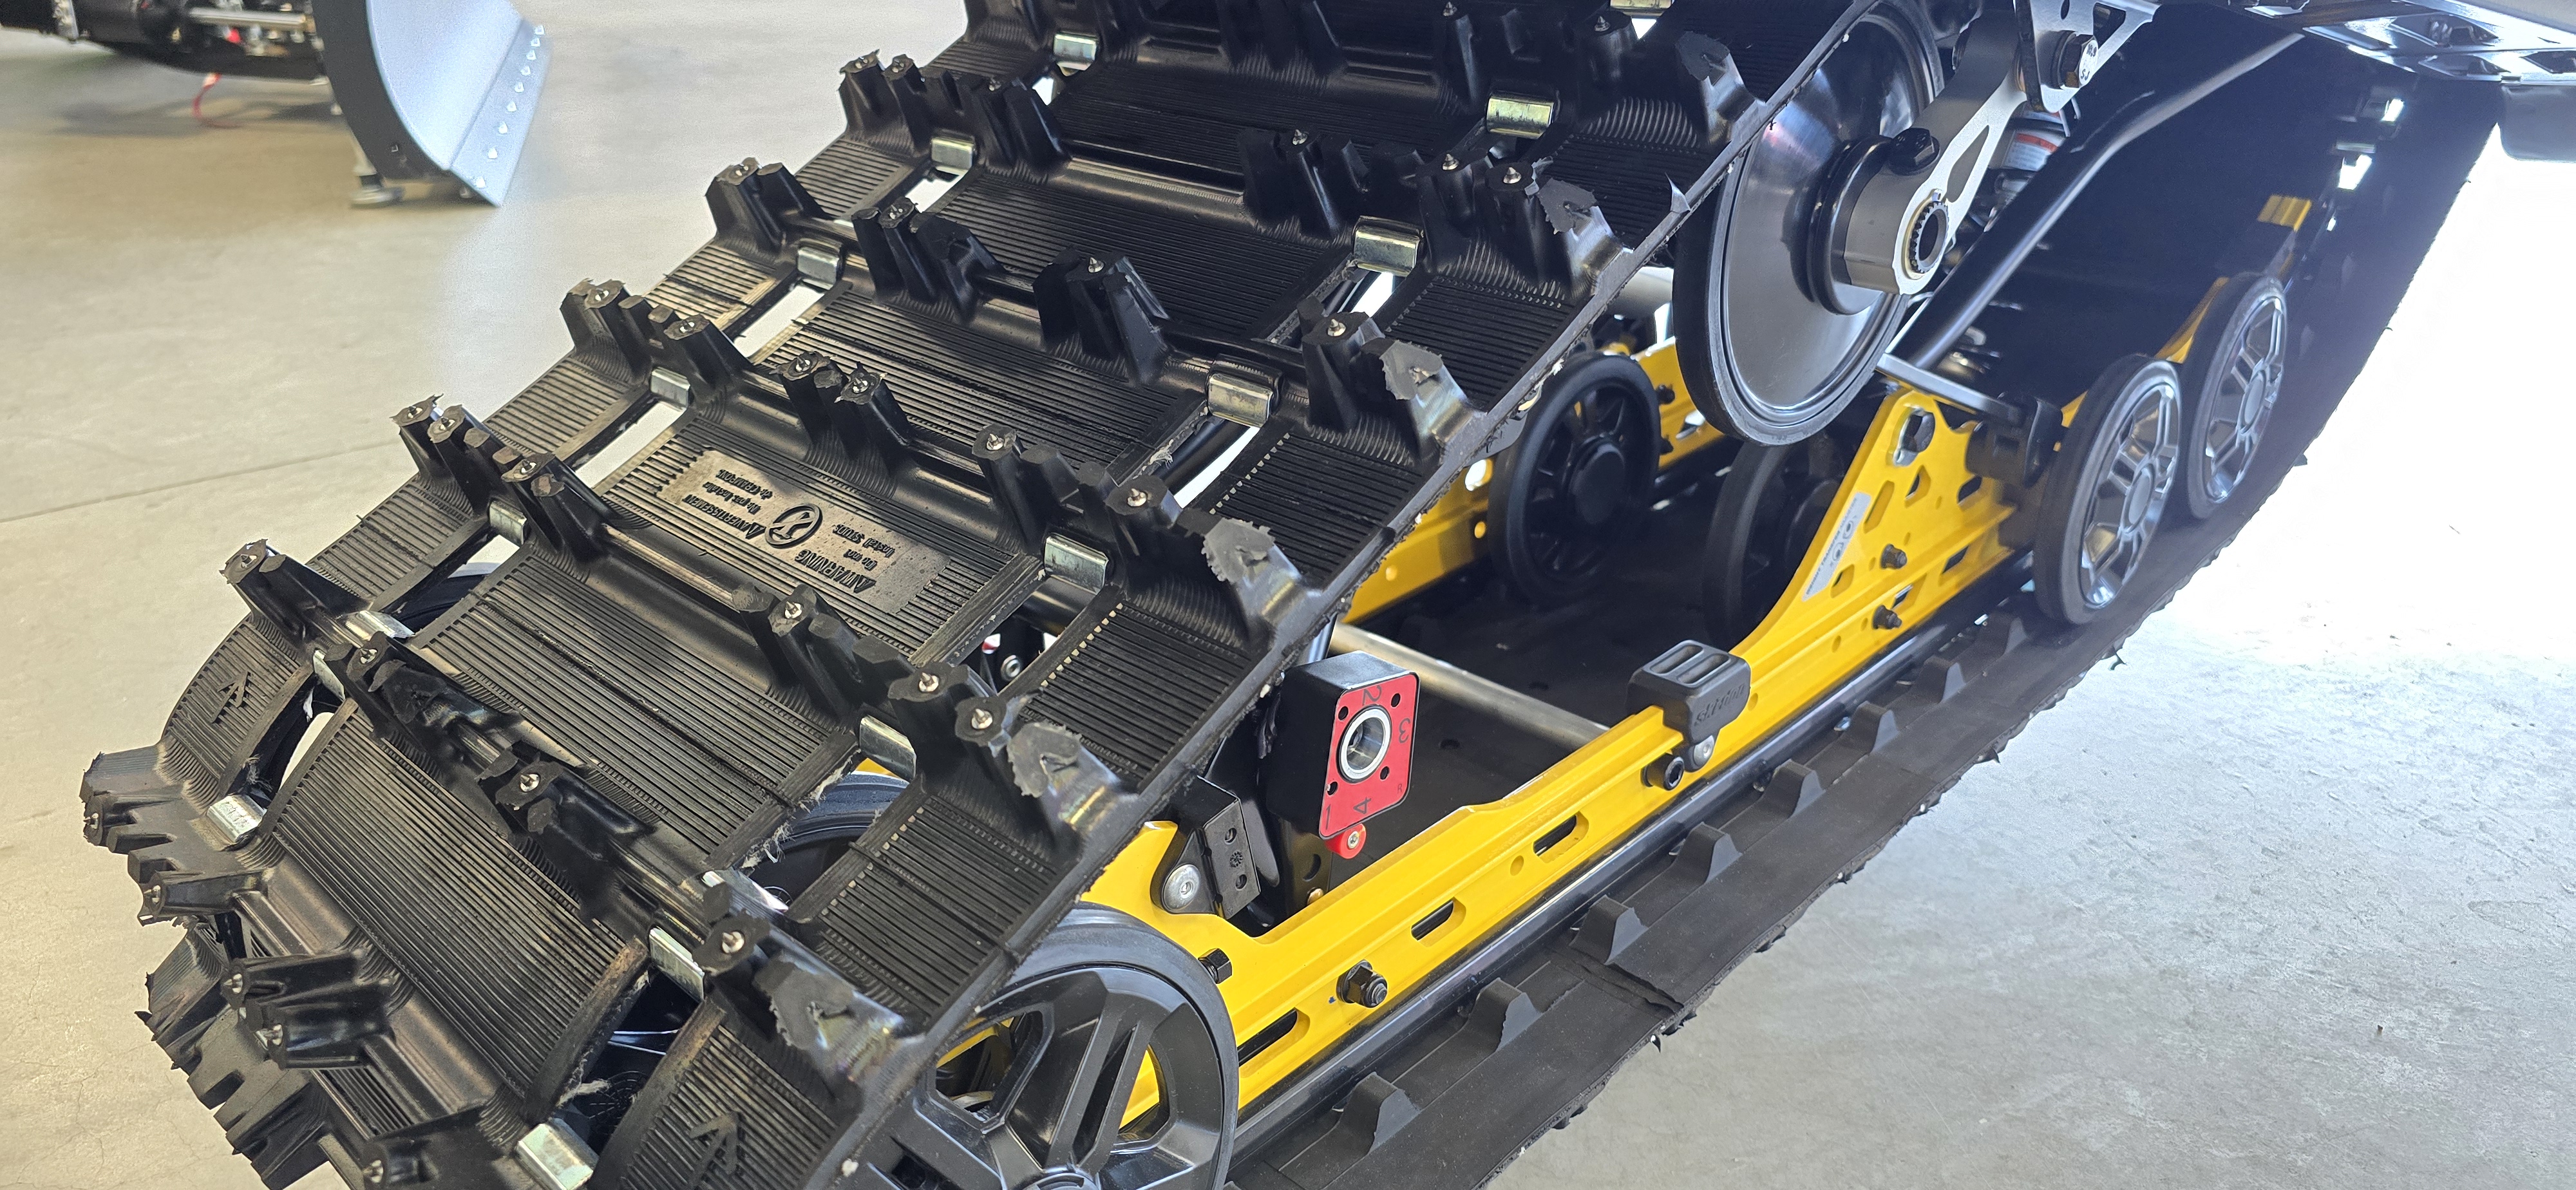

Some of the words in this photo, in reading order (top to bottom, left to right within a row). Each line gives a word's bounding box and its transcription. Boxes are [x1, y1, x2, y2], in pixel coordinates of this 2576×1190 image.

[715, 469, 761, 495] CRAMPONS
[862, 537, 896, 558] Install
[795, 549, 862, 590] WARNING
[1361, 685, 1382, 706] 2
[1399, 717, 1411, 744] 3
[1397, 783, 1403, 794] R
[1325, 804, 1331, 831] 1
[1353, 797, 1372, 815] 4
